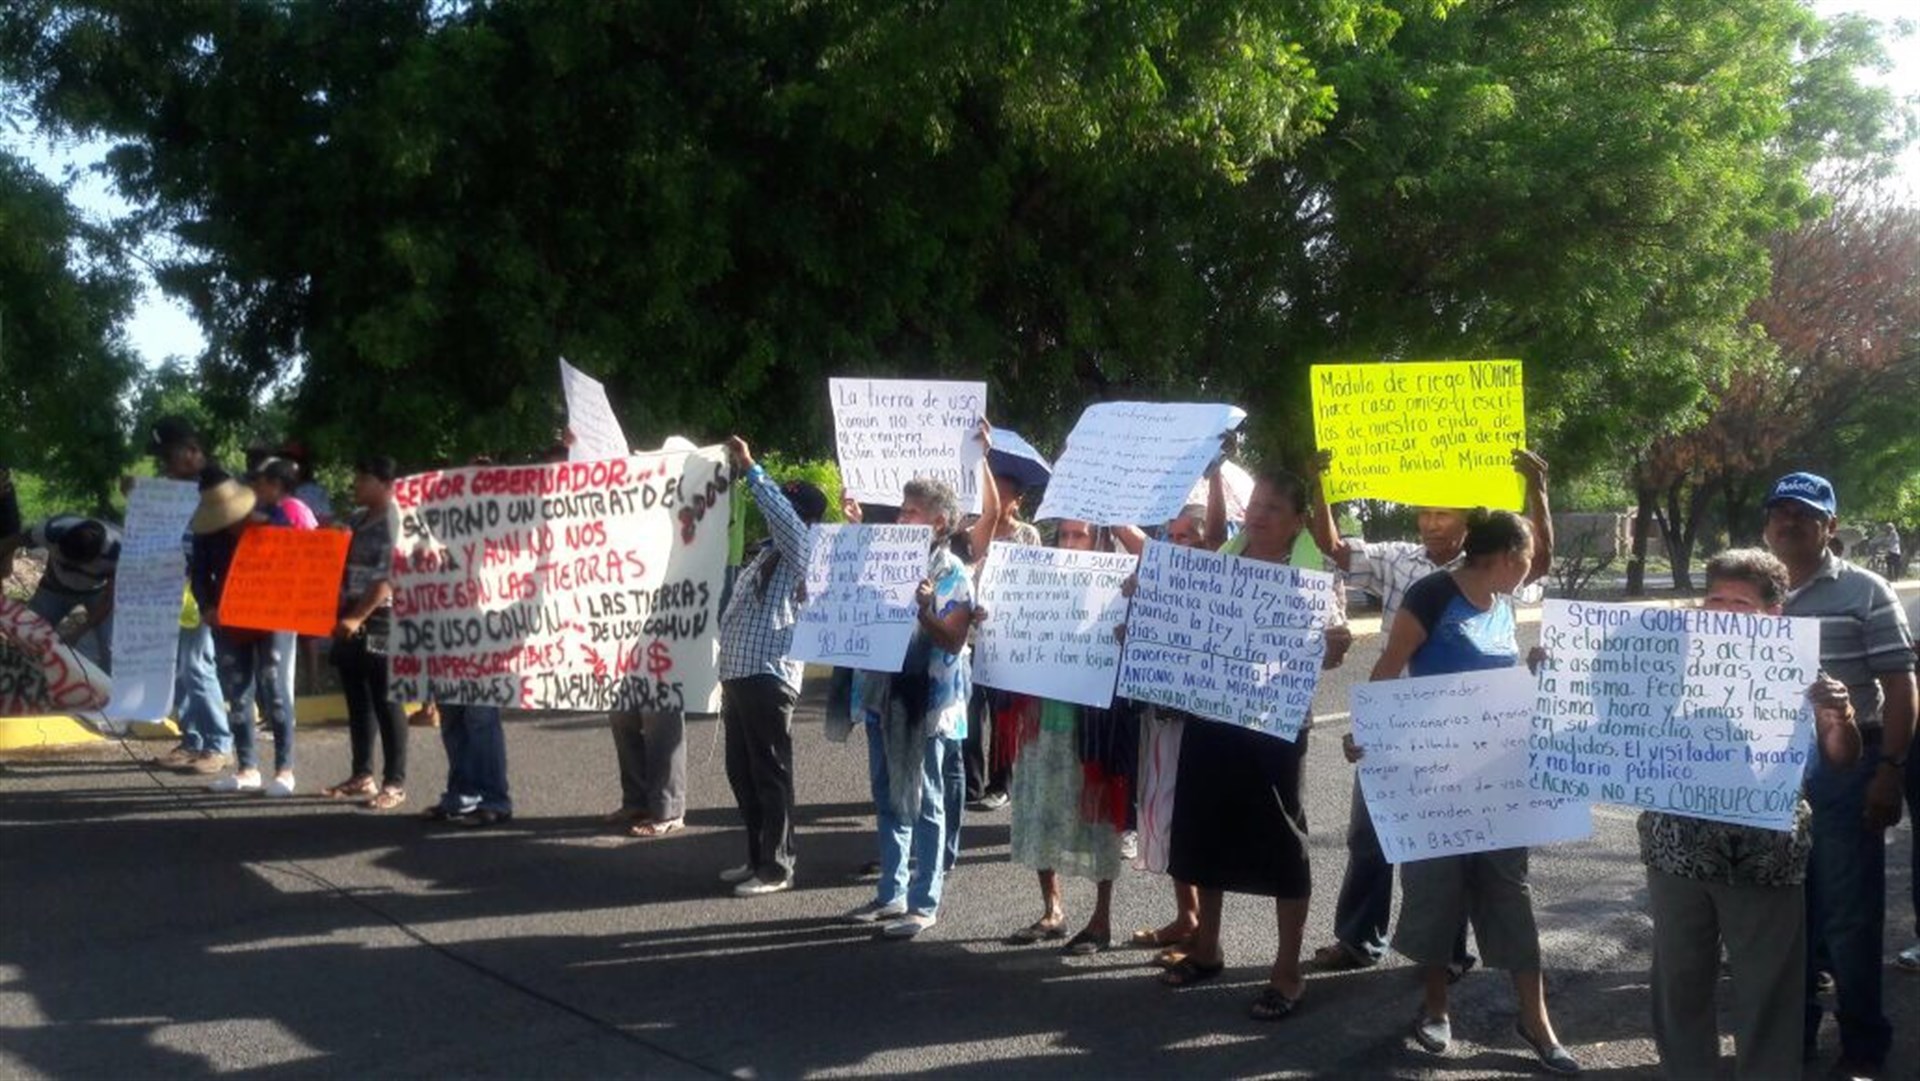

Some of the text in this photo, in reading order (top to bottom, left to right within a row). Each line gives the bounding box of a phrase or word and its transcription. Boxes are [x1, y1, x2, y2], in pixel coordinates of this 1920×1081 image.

[1384, 369, 1407, 393] de
[921, 389, 939, 409] de
[1346, 421, 1363, 439] de
[1493, 413, 1512, 430] de
[506, 499, 535, 526] UN
[565, 520, 607, 551] NOS
[535, 549, 646, 593] TIERRAS
[587, 579, 711, 618] LAS TIERRAS
[398, 618, 436, 653] DE
[440, 617, 482, 652] USO
[588, 620, 610, 643] DE
[613, 618, 643, 641] USO
[1641, 607, 1795, 641] GOBERNADOR
[1543, 624, 1795, 664] Se elaboraron 3 actas
[1569, 652, 1677, 675] asambleas
[1686, 656, 1752, 680] duras
[1537, 669, 1775, 710] la misma fecha y la
[1536, 696, 1595, 717] misma
[1607, 696, 1651, 719] hora
[1682, 698, 1744, 721] firmas
[1752, 701, 1809, 724] hechas
[1531, 715, 1554, 737] en
[1546, 755, 1611, 777] notario
[1624, 740, 1641, 760] El
[1648, 739, 1739, 763] visitador
[1743, 744, 1806, 773] Agrario
[1601, 782, 1626, 801] NO
[1634, 785, 1656, 807] ES
